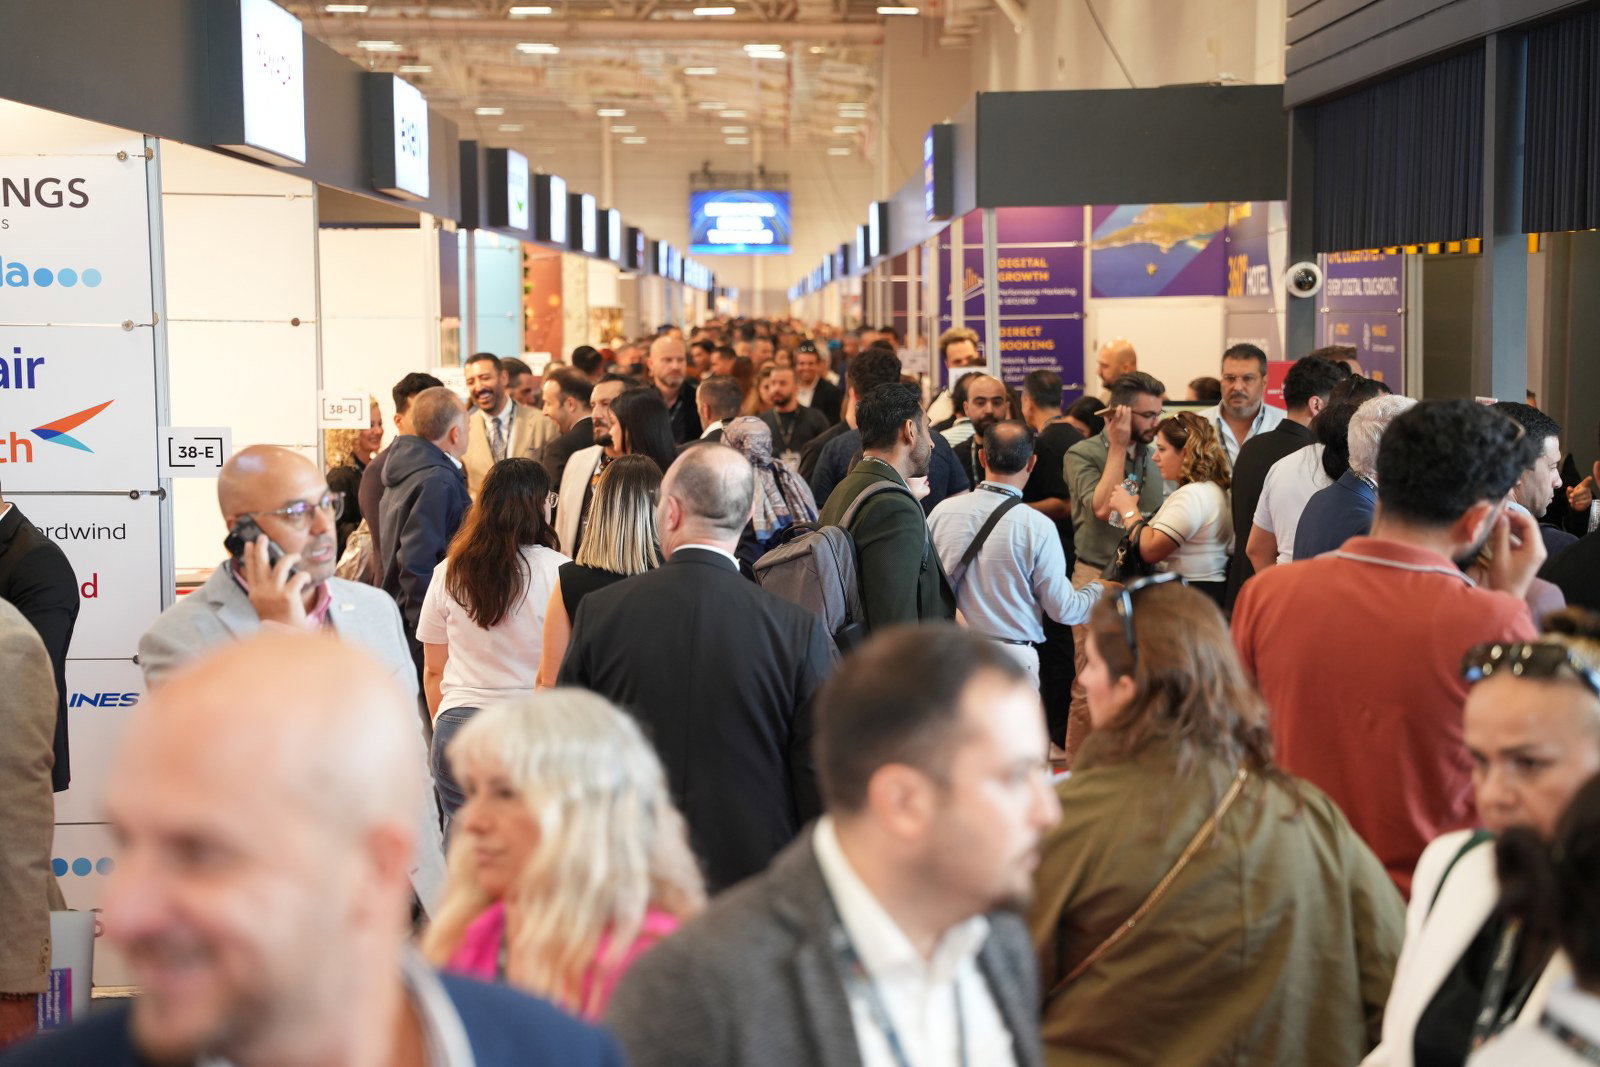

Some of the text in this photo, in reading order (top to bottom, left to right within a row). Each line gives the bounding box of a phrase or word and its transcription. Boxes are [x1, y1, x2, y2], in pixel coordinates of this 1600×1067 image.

[2, 177, 90, 209] NGS
[997, 257, 1049, 269] DIGITAL
[997, 271, 1050, 282] GROWTH
[1245, 264, 1270, 295] HOTEL
[1041, 287, 1078, 298] Marketing
[999, 326, 1043, 337] DIRECT
[999, 339, 1056, 351] BOOKING
[329, 404, 357, 414] 38-D
[178, 446, 214, 459] 38-E
[68, 692, 140, 708] INES
